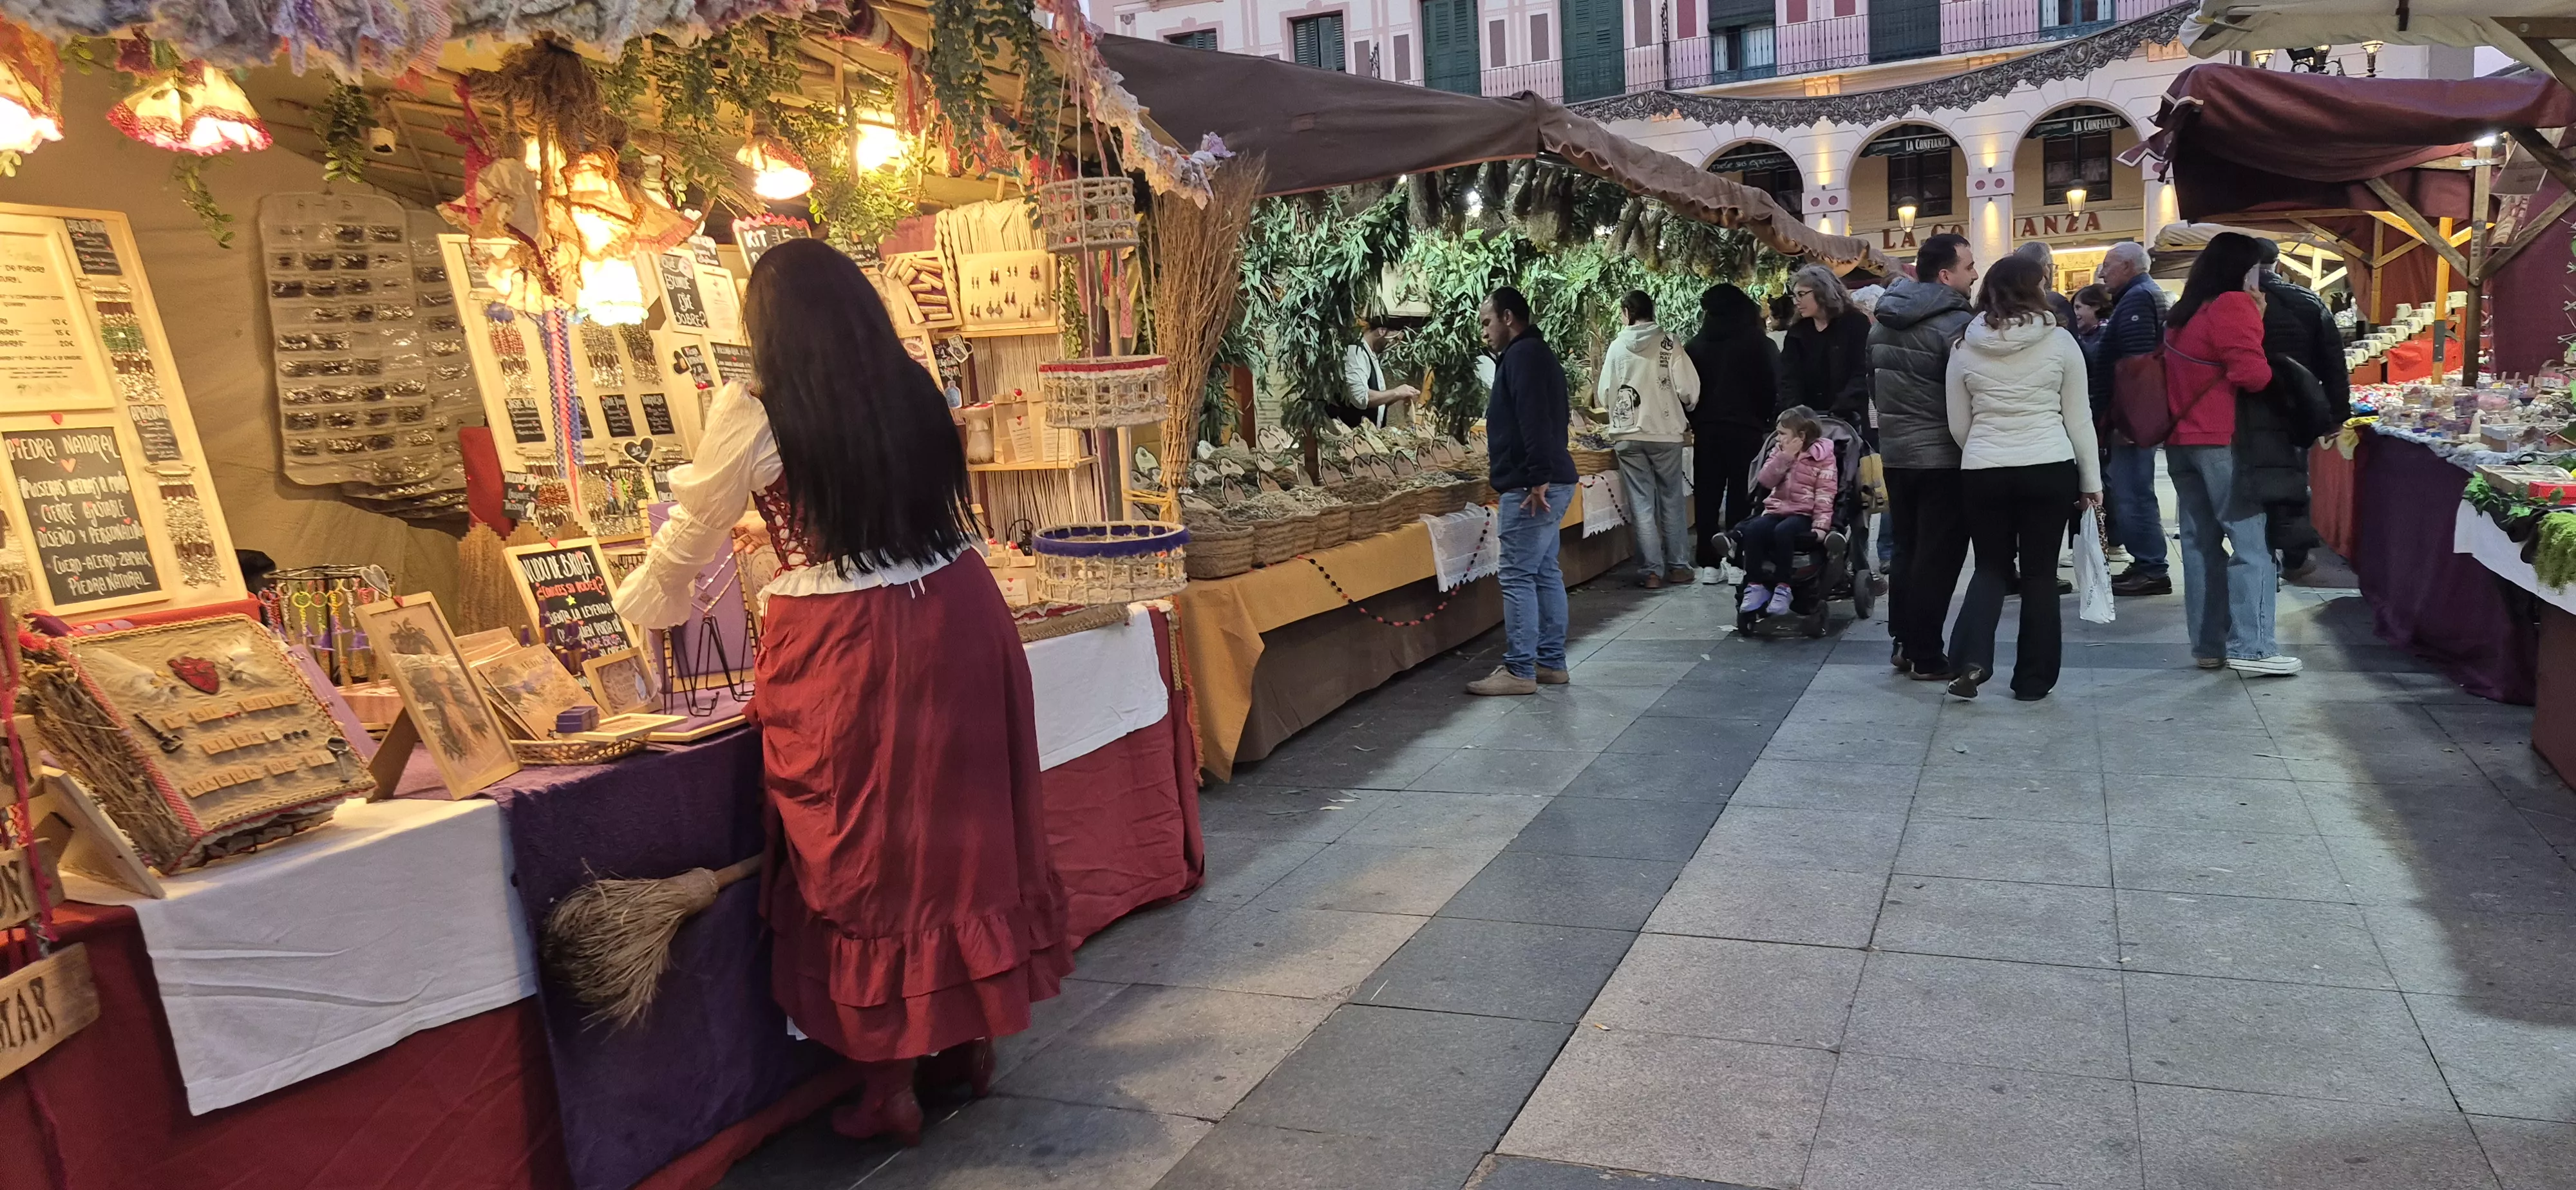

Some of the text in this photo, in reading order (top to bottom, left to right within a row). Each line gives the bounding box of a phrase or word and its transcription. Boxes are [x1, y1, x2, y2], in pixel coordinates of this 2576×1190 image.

[2073, 120, 2082, 132] LA
[2084, 117, 2121, 131] CONFIANZA
[1906, 140, 1913, 151] LA
[1915, 137, 1951, 149] CONFIANZA
[743, 230, 767, 247] KIT
[1882, 229, 1917, 249] LA
[676, 310, 706, 327] SOBRE?
[5, 438, 57, 464] PIEDRA
[62, 435, 120, 463] NATURAL
[41, 503, 77, 525] CIERRE
[37, 527, 75, 548] DISEÑO
[519, 551, 594, 583] NUDO DE BRUJA
[68, 576, 108, 596] PIEDRA
[580, 603, 613, 618] LEYENDA
[242, 694, 298, 709] ESTE
[207, 728, 281, 752] LIBRO
[185, 766, 260, 794] HABLA
